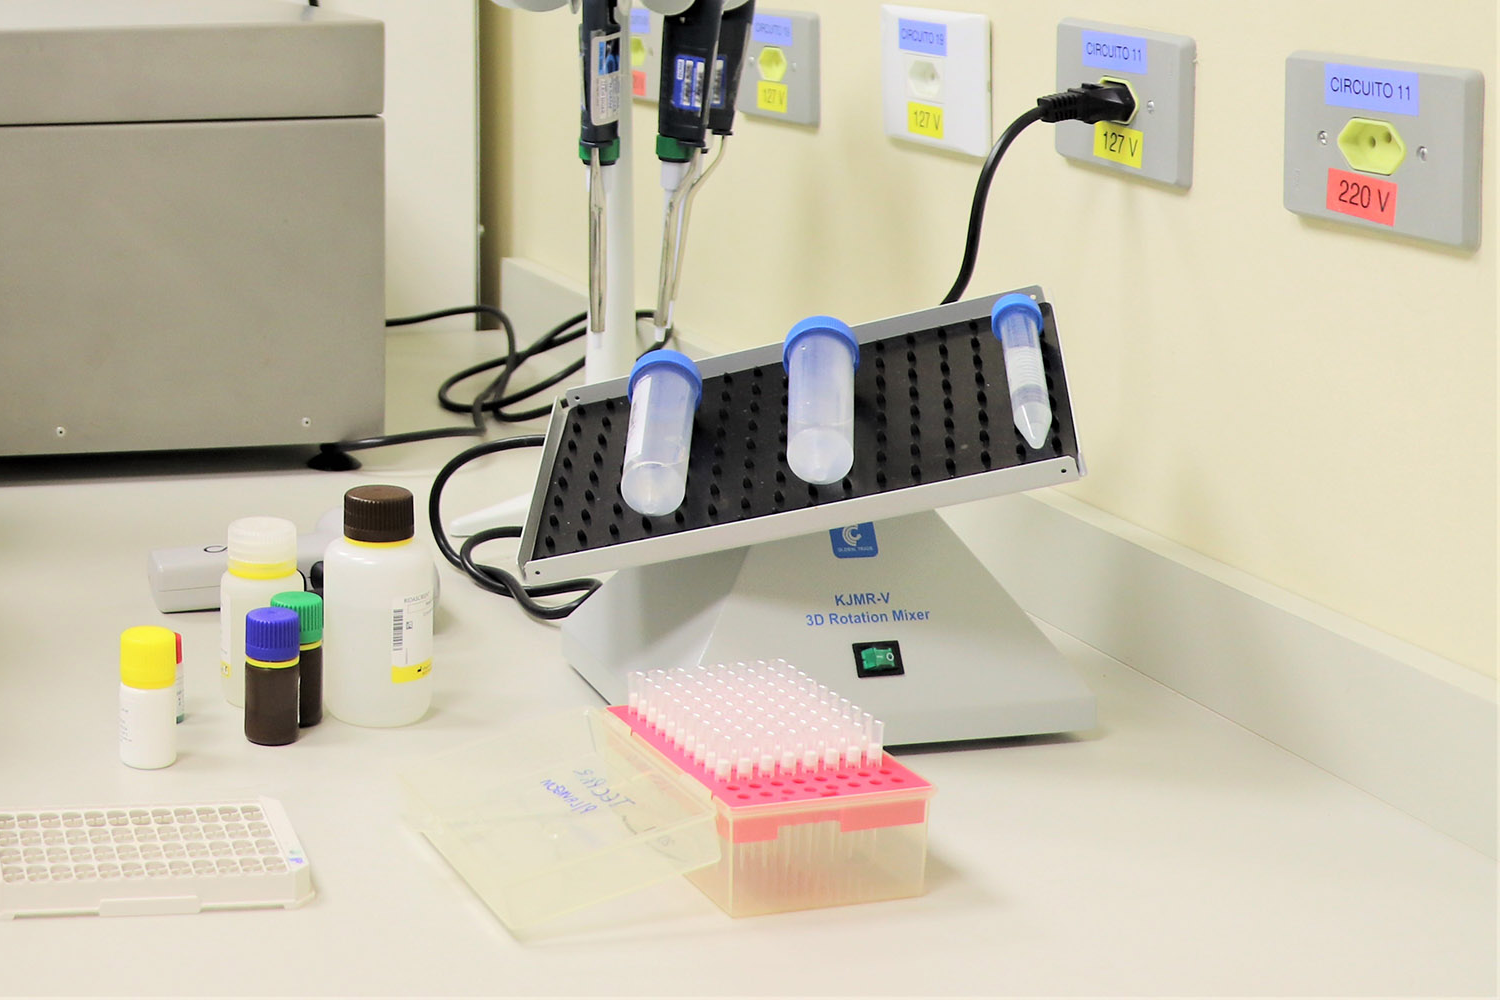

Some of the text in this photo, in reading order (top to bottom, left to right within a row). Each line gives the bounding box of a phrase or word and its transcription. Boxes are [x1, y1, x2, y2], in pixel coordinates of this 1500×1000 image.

[901, 28, 935, 45] CIRCUITO
[1085, 41, 1143, 62] CIRCUITO 11
[763, 87, 786, 107] 127 V
[1330, 76, 1411, 101] CIRCUITO 11
[913, 109, 941, 131] 127 V
[1102, 130, 1139, 158] 127 V
[1338, 178, 1391, 213] 220 V
[834, 592, 890, 607] KJMR-V
[806, 608, 931, 627] 3D Rotation Mixer
